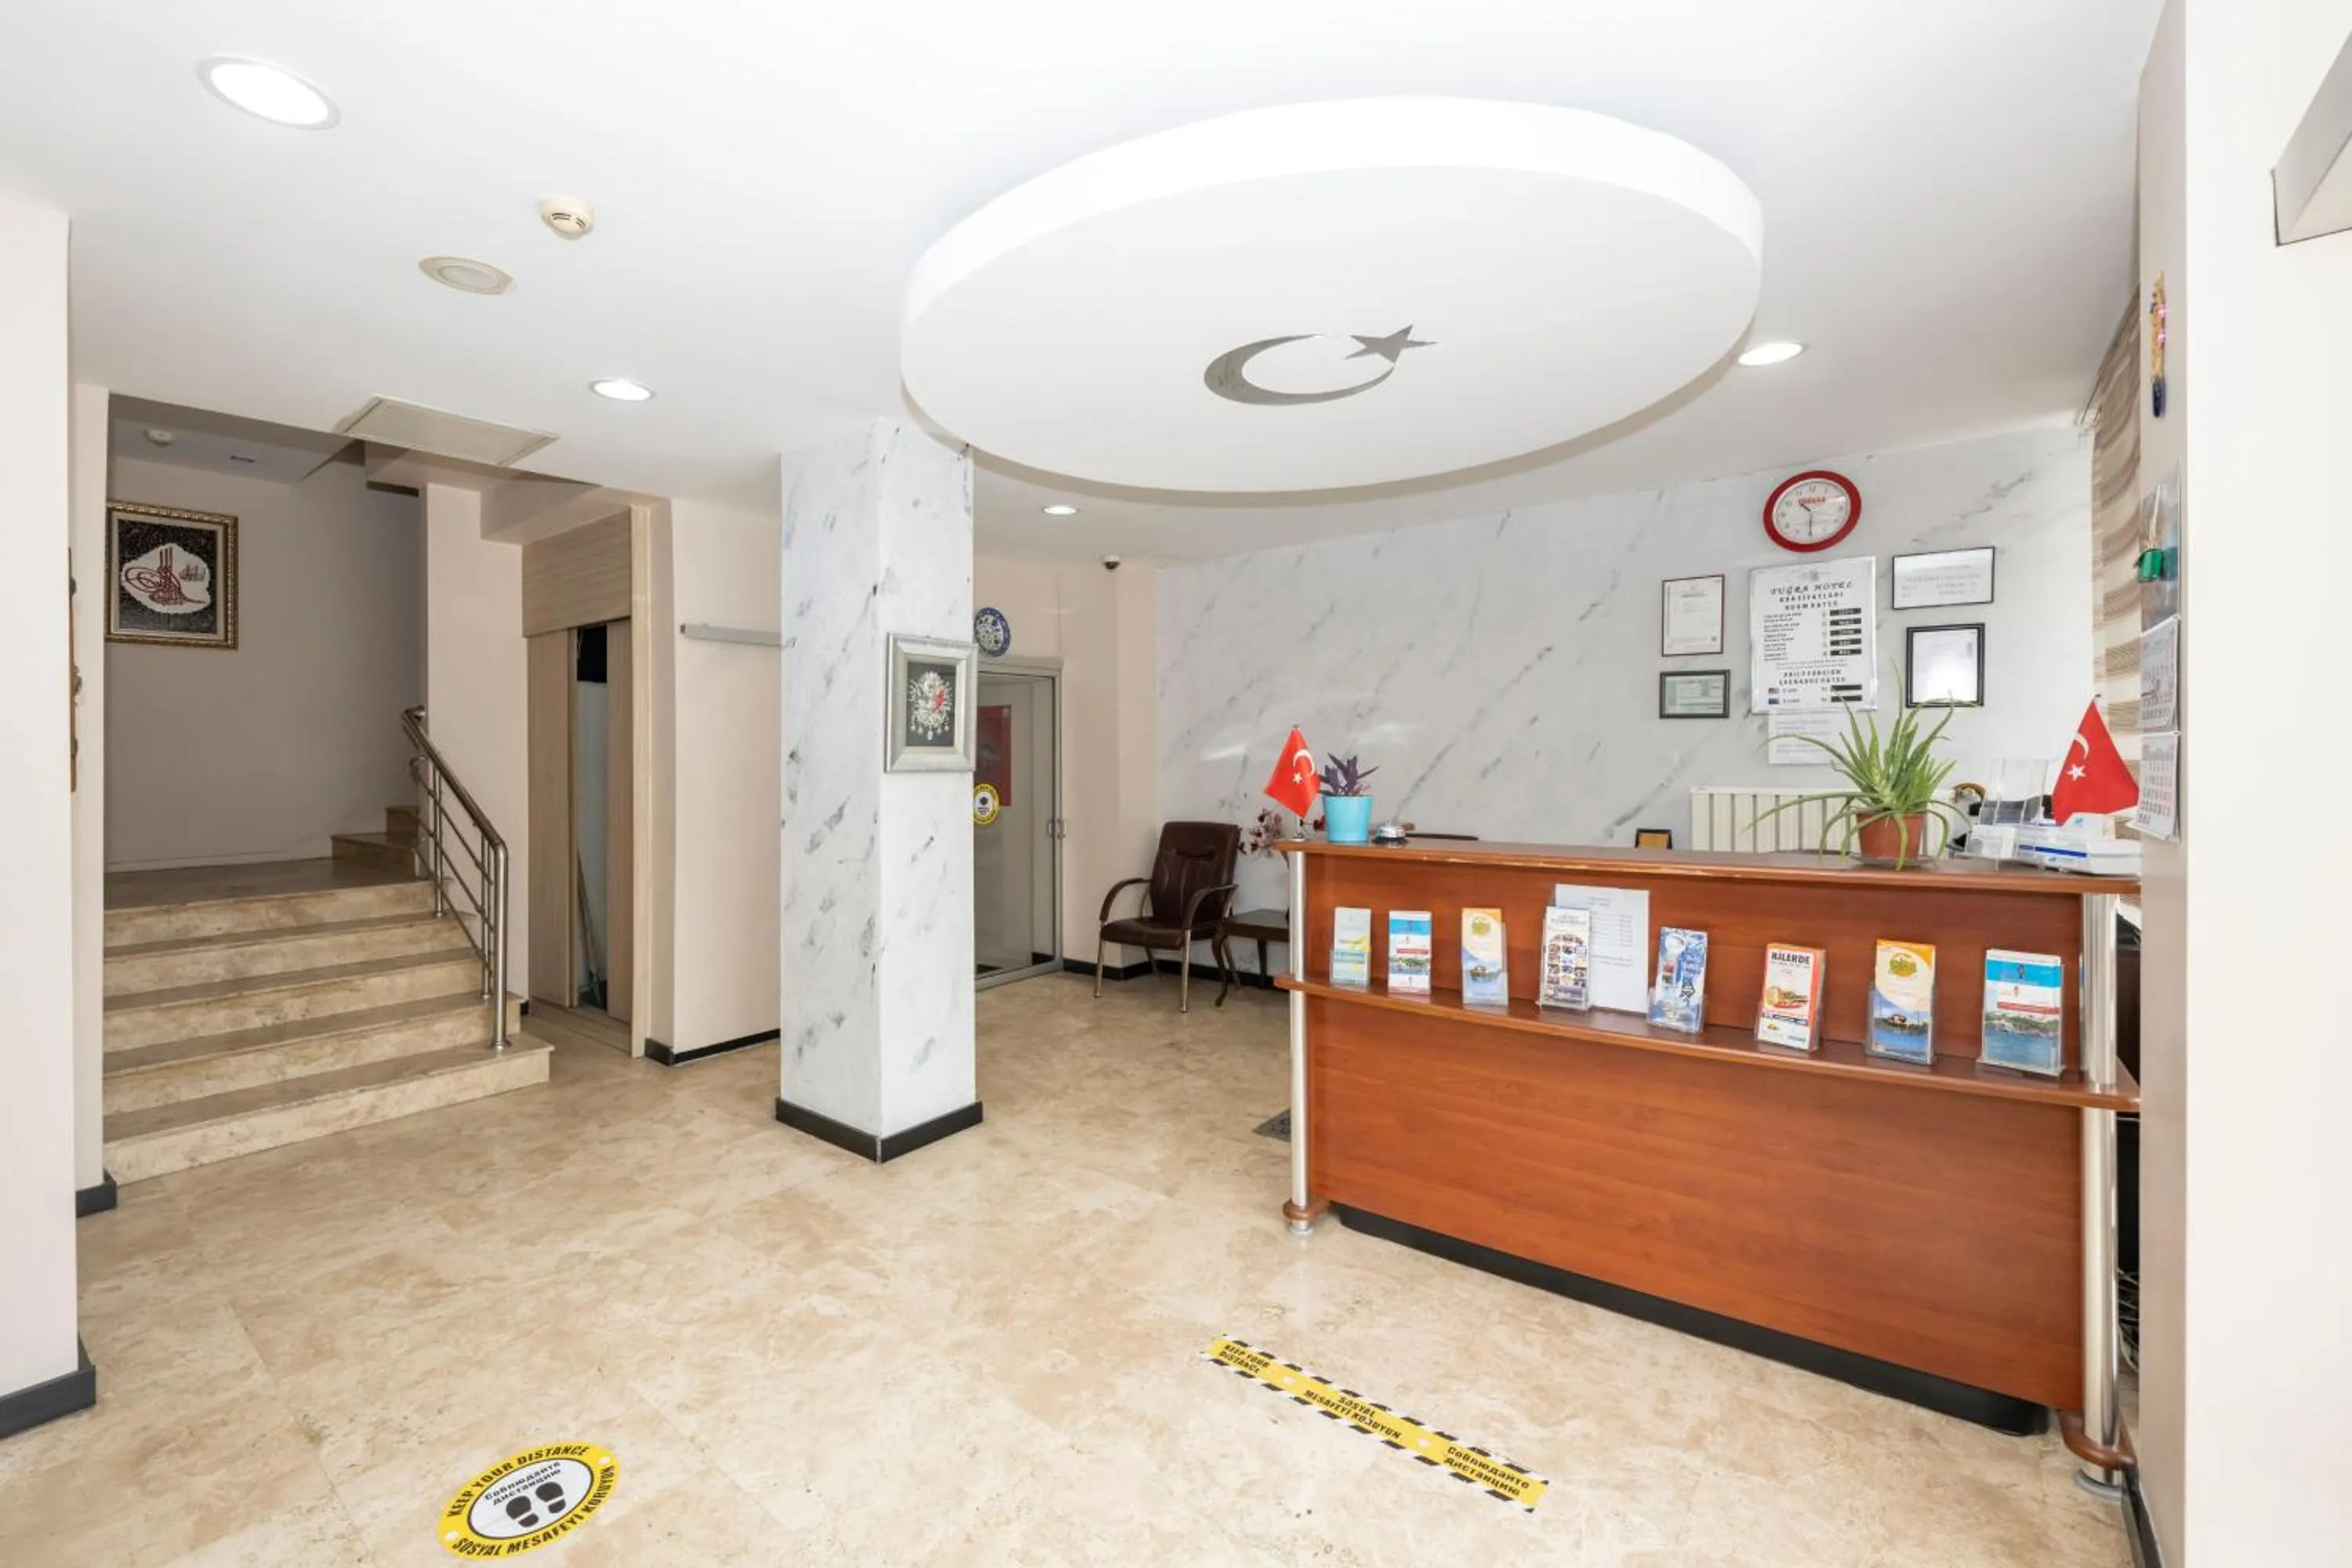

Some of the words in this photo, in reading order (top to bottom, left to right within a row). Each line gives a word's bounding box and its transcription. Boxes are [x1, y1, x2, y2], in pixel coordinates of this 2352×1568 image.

[1813, 581, 1852, 592] HOTEL
[1219, 1350, 1260, 1374] DISTANCE
[1224, 1344, 1246, 1355] KEEP
[1247, 1353, 1270, 1368] YOUR
[1338, 1396, 1376, 1417] SOSYAL
[446, 1490, 474, 1518] KEEP
[472, 1461, 514, 1490] YOUR
[517, 1445, 590, 1465] DISTANCE
[452, 1537, 503, 1556] SOSYAL
[581, 1465, 616, 1514] KORUYUN
